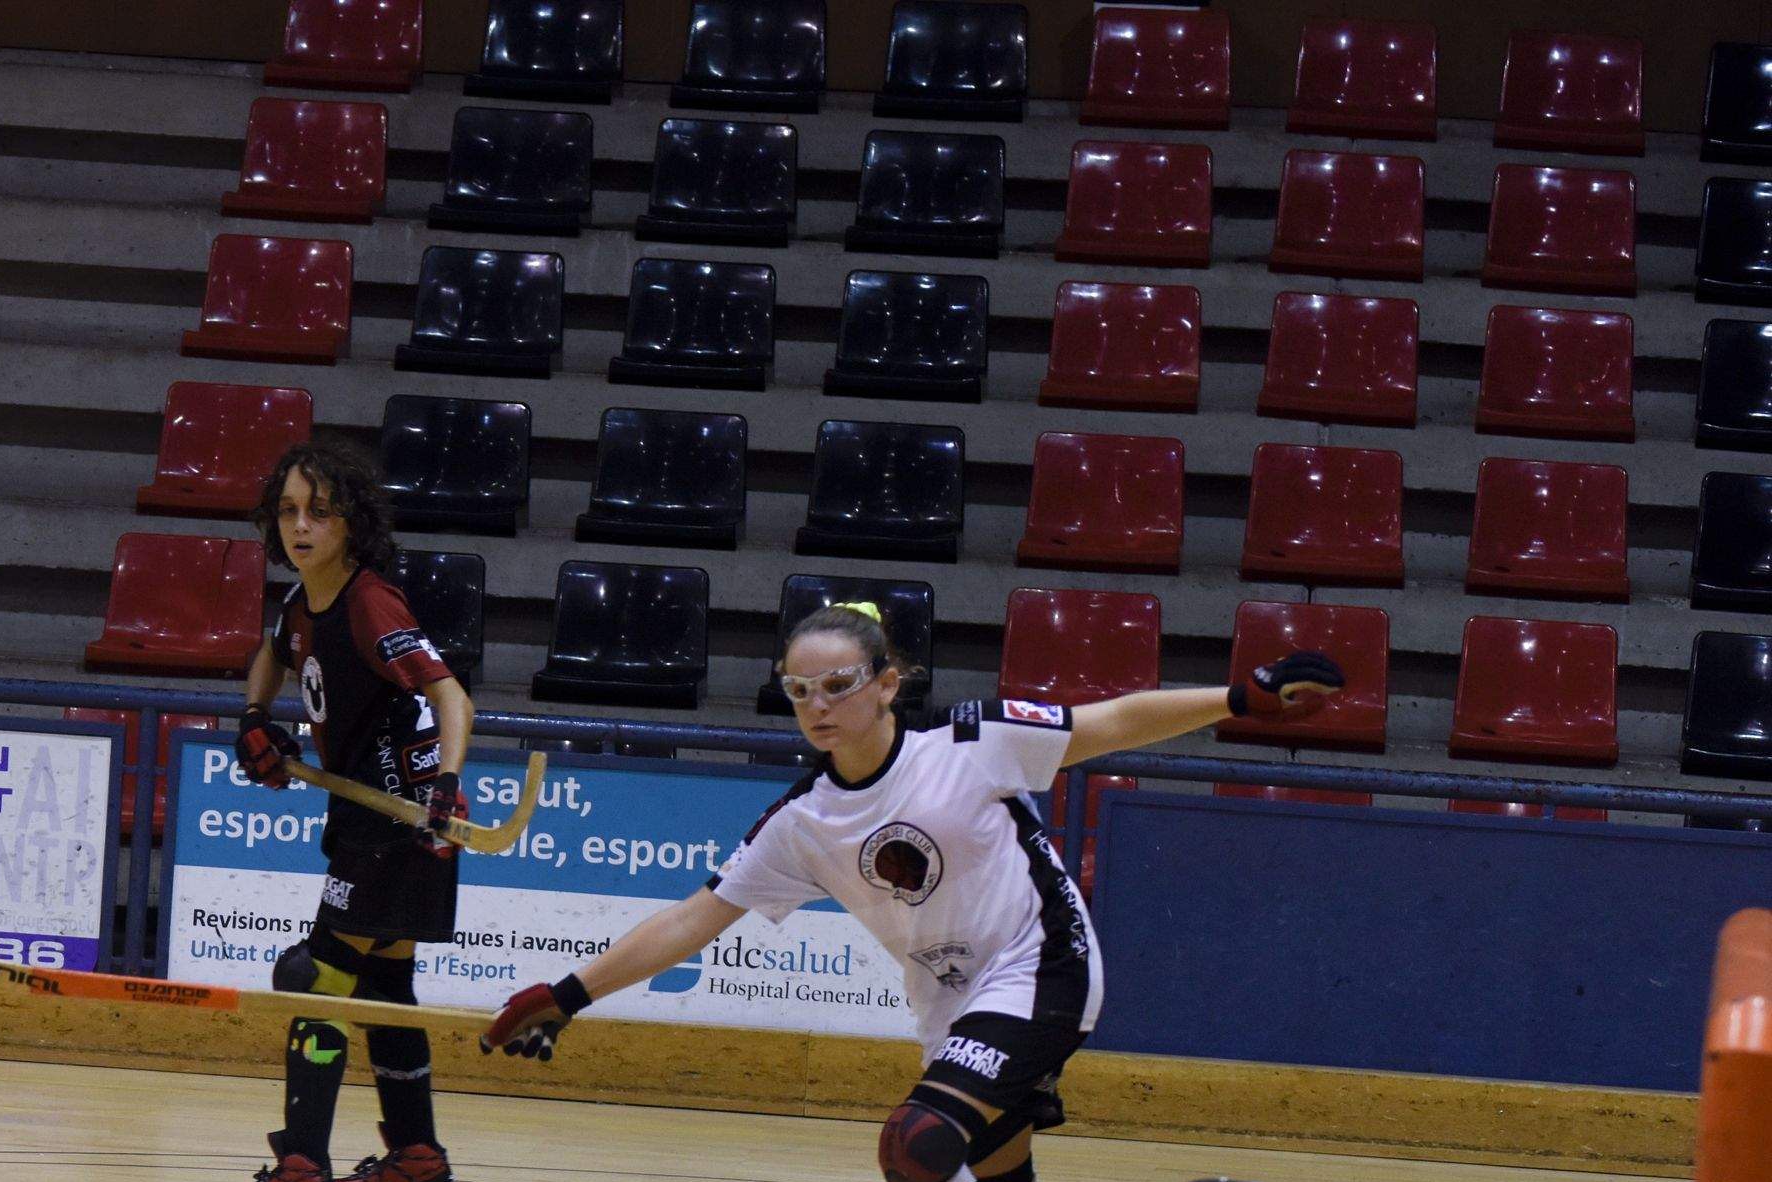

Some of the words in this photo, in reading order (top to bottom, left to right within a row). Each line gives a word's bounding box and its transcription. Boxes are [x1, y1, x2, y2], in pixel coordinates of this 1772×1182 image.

[476, 769, 593, 817] saut,
[192, 908, 292, 932] Revisions
[510, 930, 517, 949] i
[191, 940, 258, 962] Unitat
[712, 935, 852, 977] idcsalud
[709, 977, 790, 1001] Hospital
[796, 983, 872, 1007] General
[878, 989, 900, 1008] de
